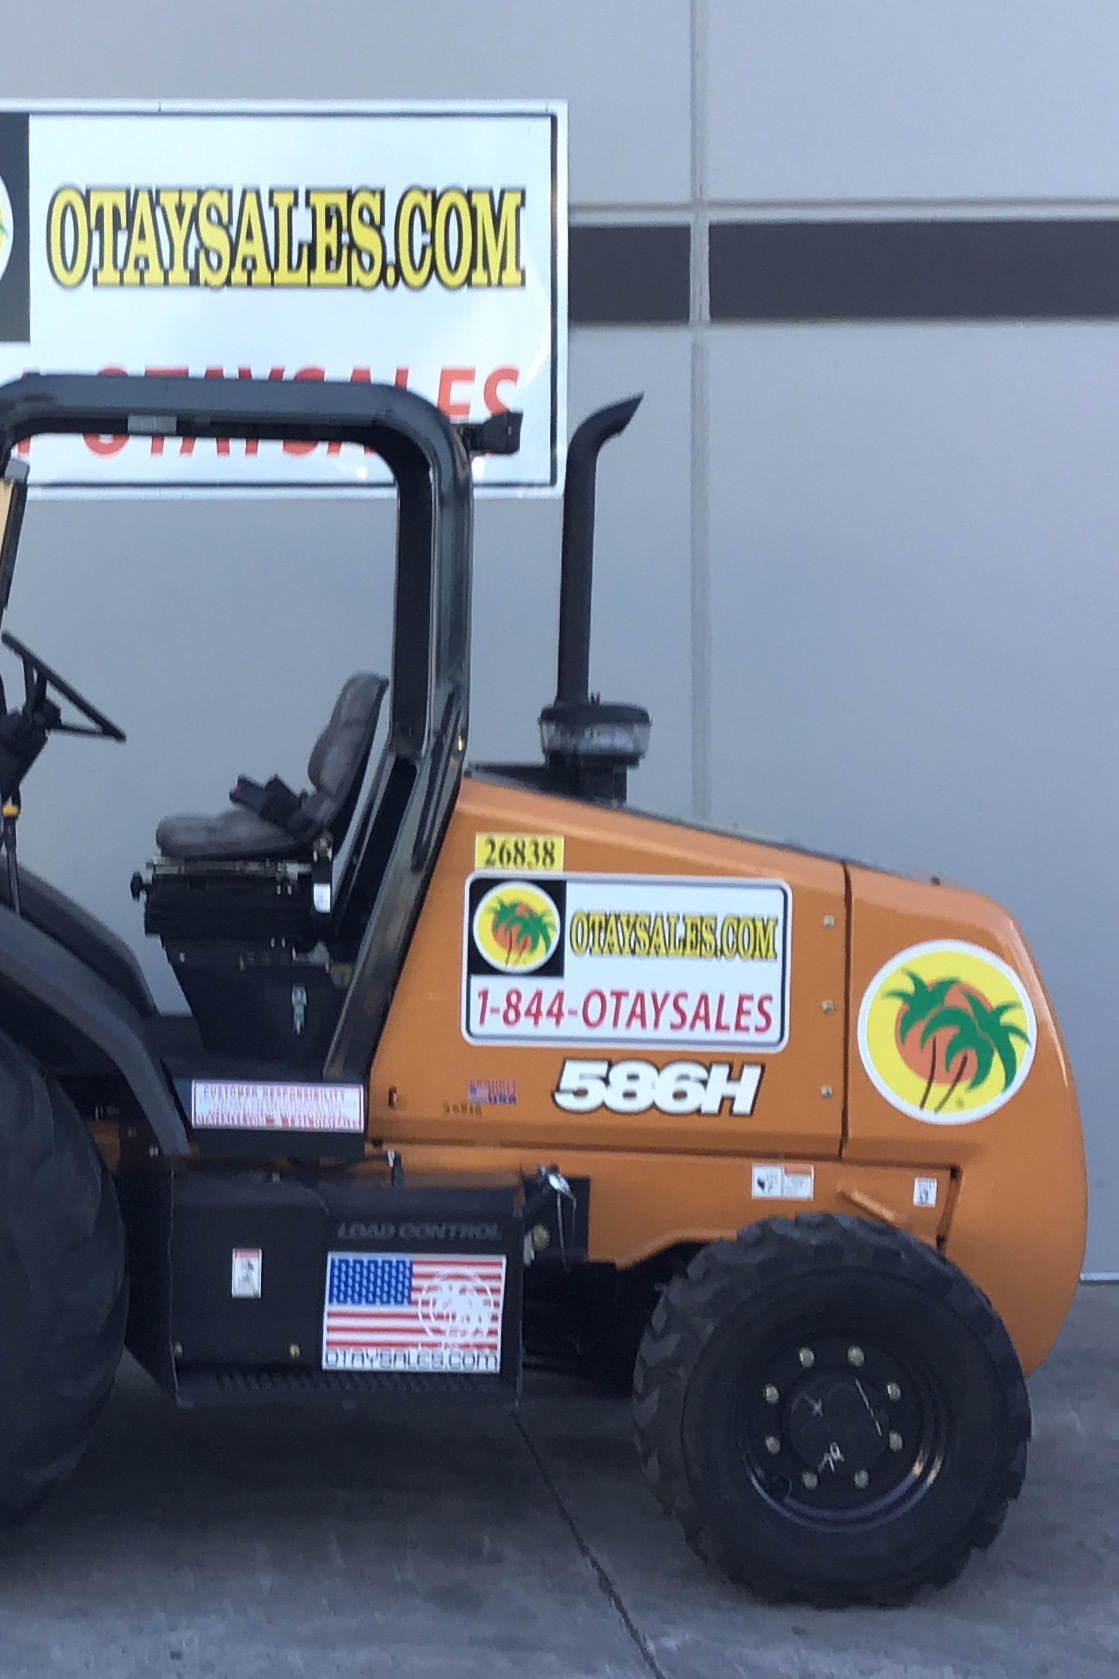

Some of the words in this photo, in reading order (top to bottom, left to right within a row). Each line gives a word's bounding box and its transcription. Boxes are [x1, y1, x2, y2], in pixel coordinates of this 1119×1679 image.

[46, 186, 525, 290] OTAYSALES.COM
[484, 835, 557, 870] 26838
[570, 909, 779, 961] OTAYSALES.COM
[478, 987, 773, 1034] 1-844-OTAYSALES
[552, 1058, 765, 1116] 586H
[337, 1222, 395, 1240] LOAD
[398, 1222, 502, 1241] CONTROL
